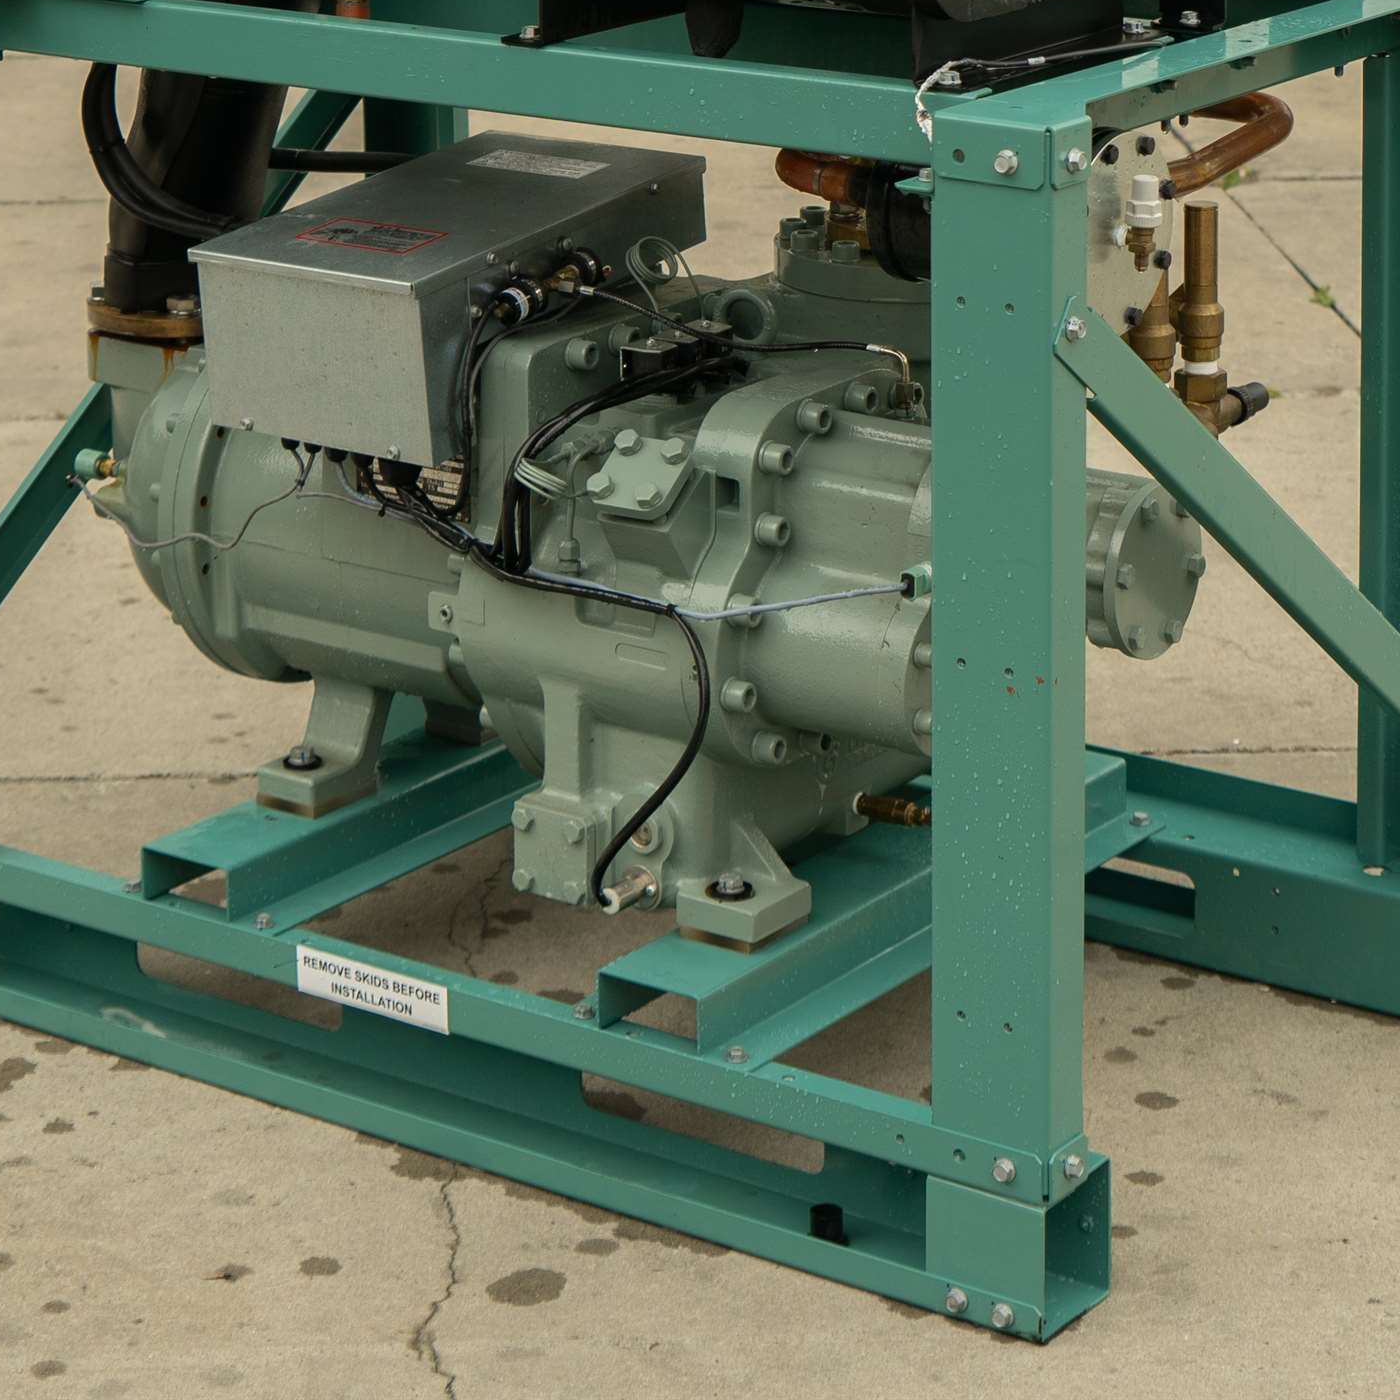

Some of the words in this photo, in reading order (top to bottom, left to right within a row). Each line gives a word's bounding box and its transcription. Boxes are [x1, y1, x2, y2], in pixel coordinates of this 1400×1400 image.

[303, 955, 351, 980] REMOVE
[354, 970, 390, 991] SKIDS
[392, 981, 441, 1005] BEFORE
[331, 982, 413, 1016] INSTALLATION
